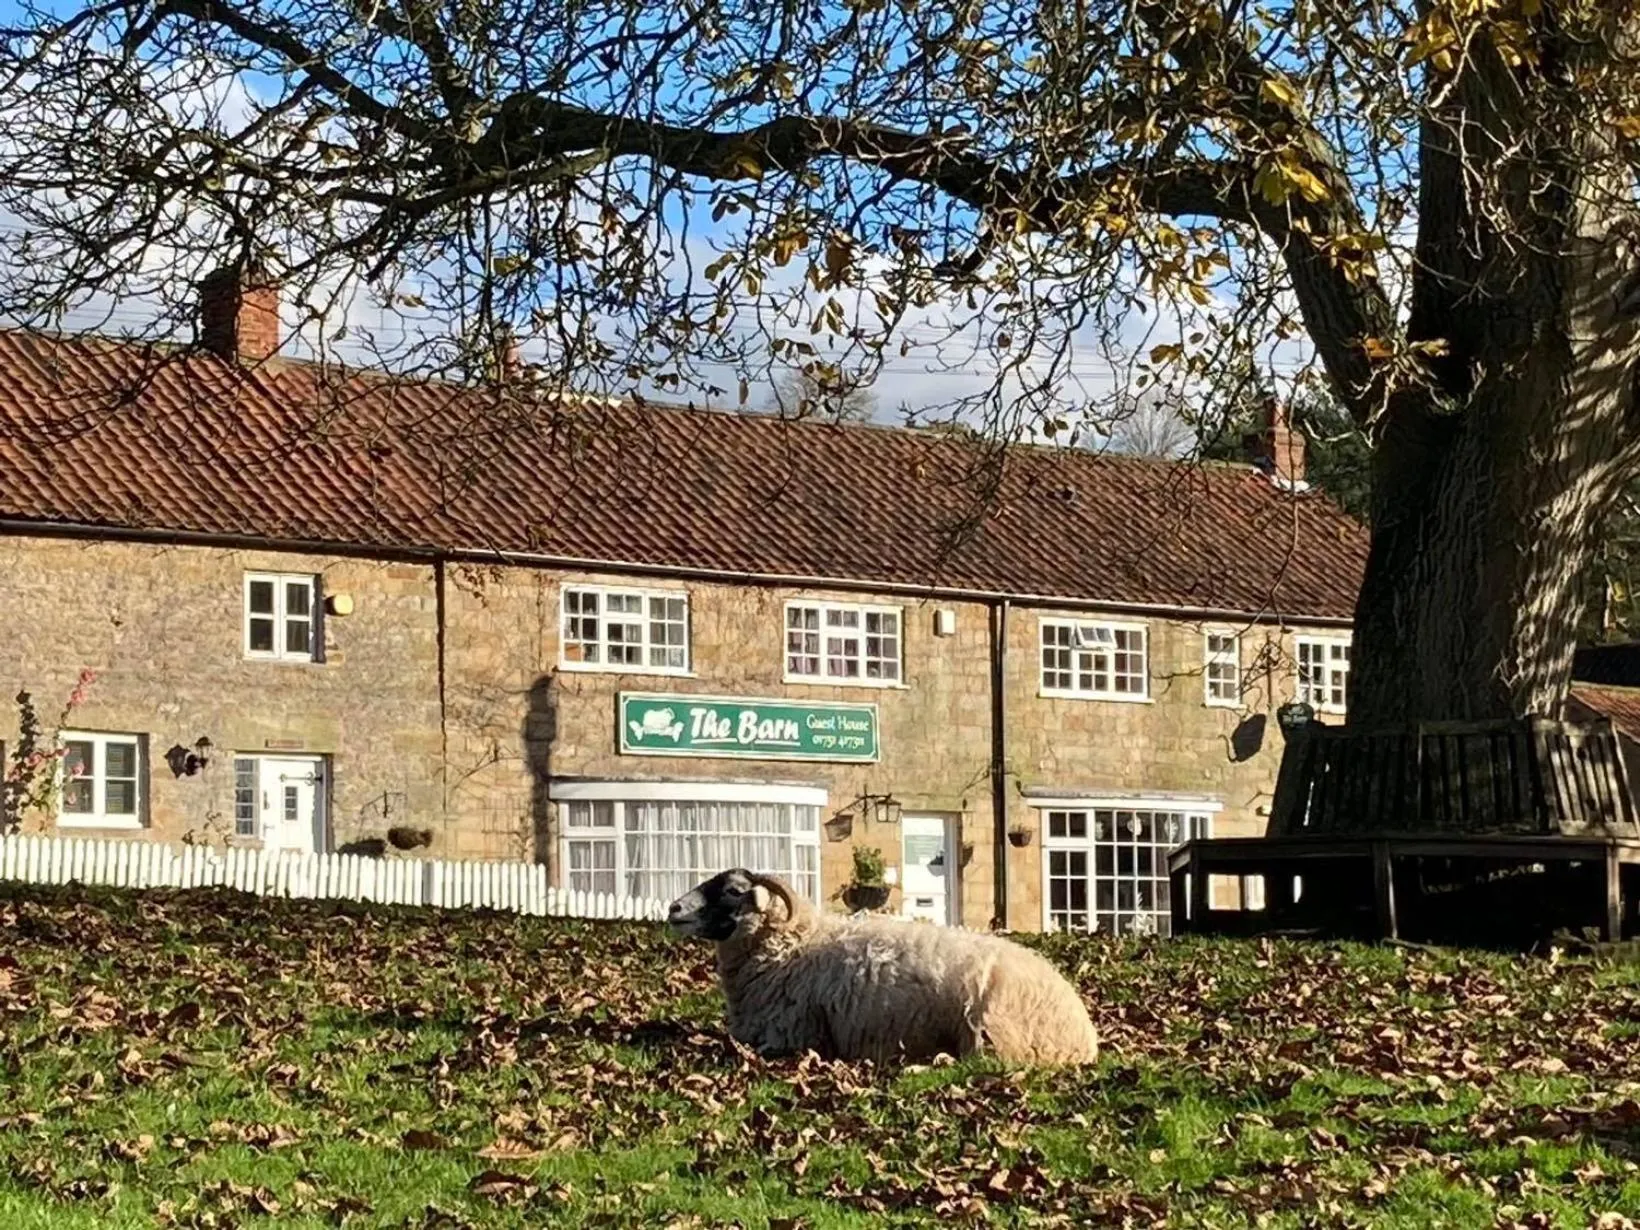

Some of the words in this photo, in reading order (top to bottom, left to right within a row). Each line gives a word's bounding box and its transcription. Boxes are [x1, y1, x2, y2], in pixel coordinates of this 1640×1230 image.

[690, 707, 731, 738] The
[737, 710, 799, 744] Barn
[806, 714, 835, 730] Guest
[837, 715, 869, 731] House
